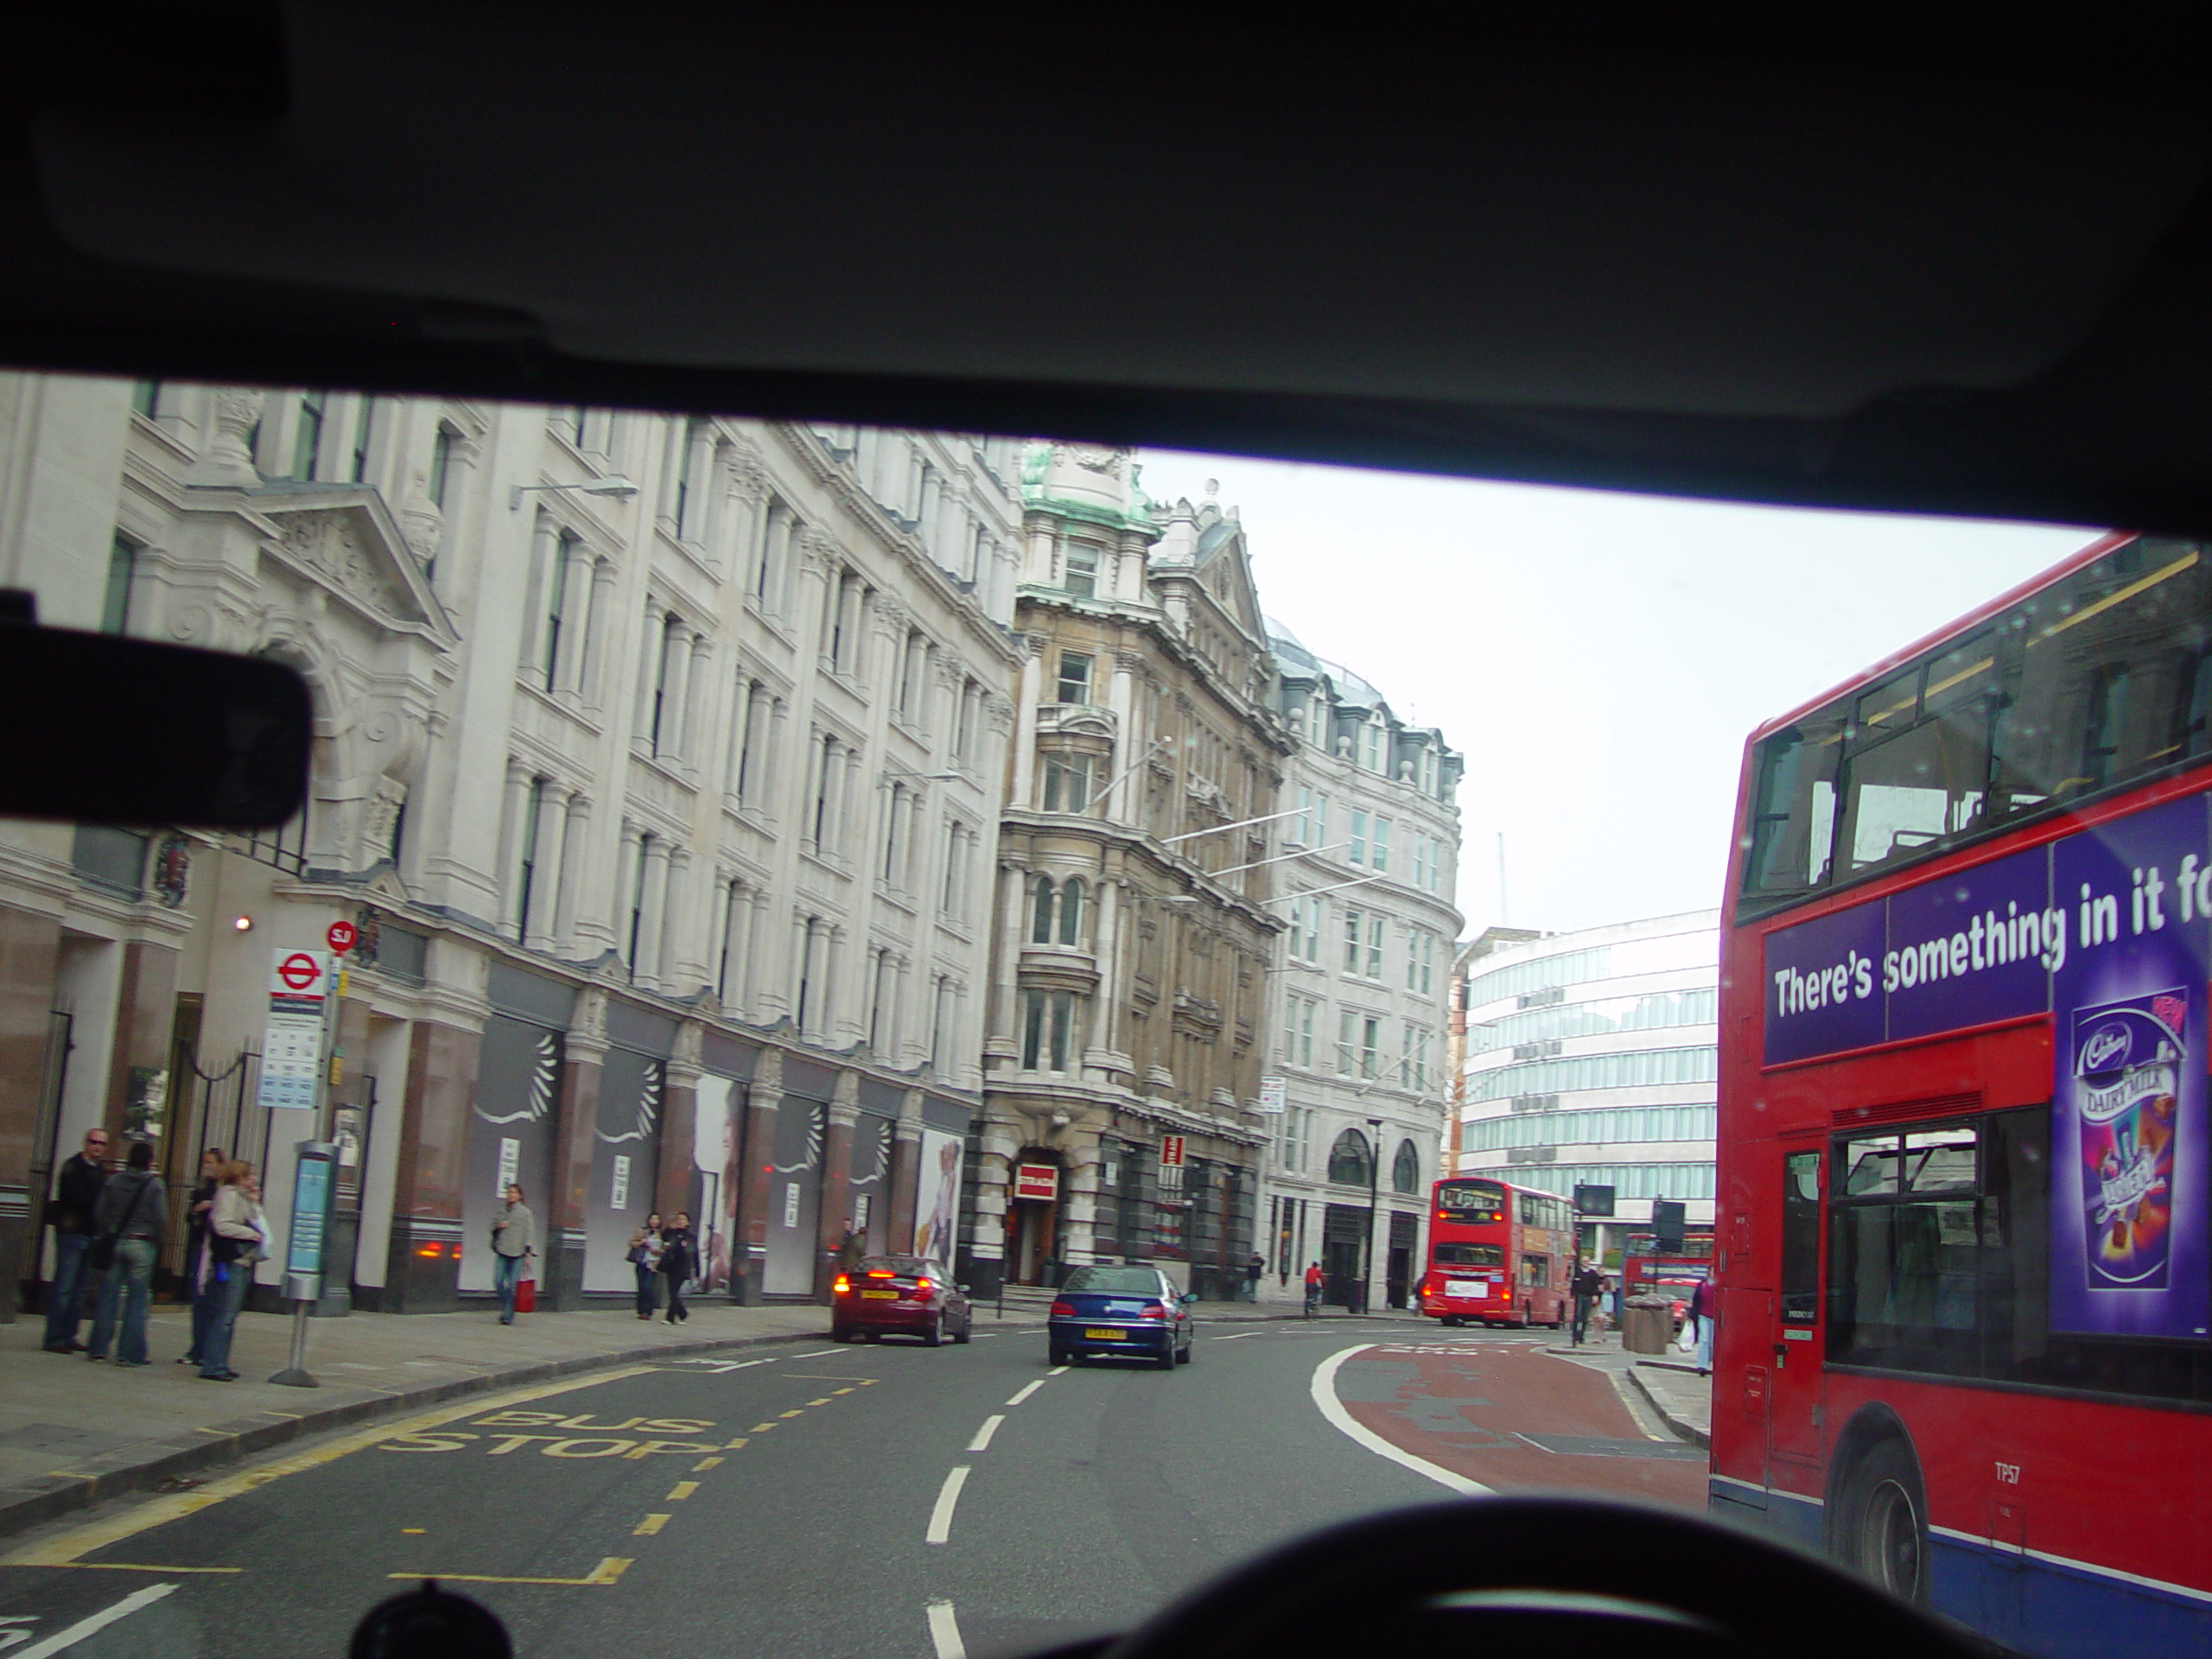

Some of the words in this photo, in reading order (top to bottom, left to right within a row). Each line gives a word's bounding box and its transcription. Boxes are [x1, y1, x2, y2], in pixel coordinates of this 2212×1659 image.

[1775, 950, 1872, 1017] There's
[1883, 900, 2066, 993] something
[2079, 882, 2119, 949] in
[2132, 867, 2165, 936] it
[2088, 1087, 2126, 1113] DAIRY
[469, 1410, 717, 1433] BUS
[378, 1432, 721, 1459] STOP
[1994, 1461, 2021, 1484] TP57
